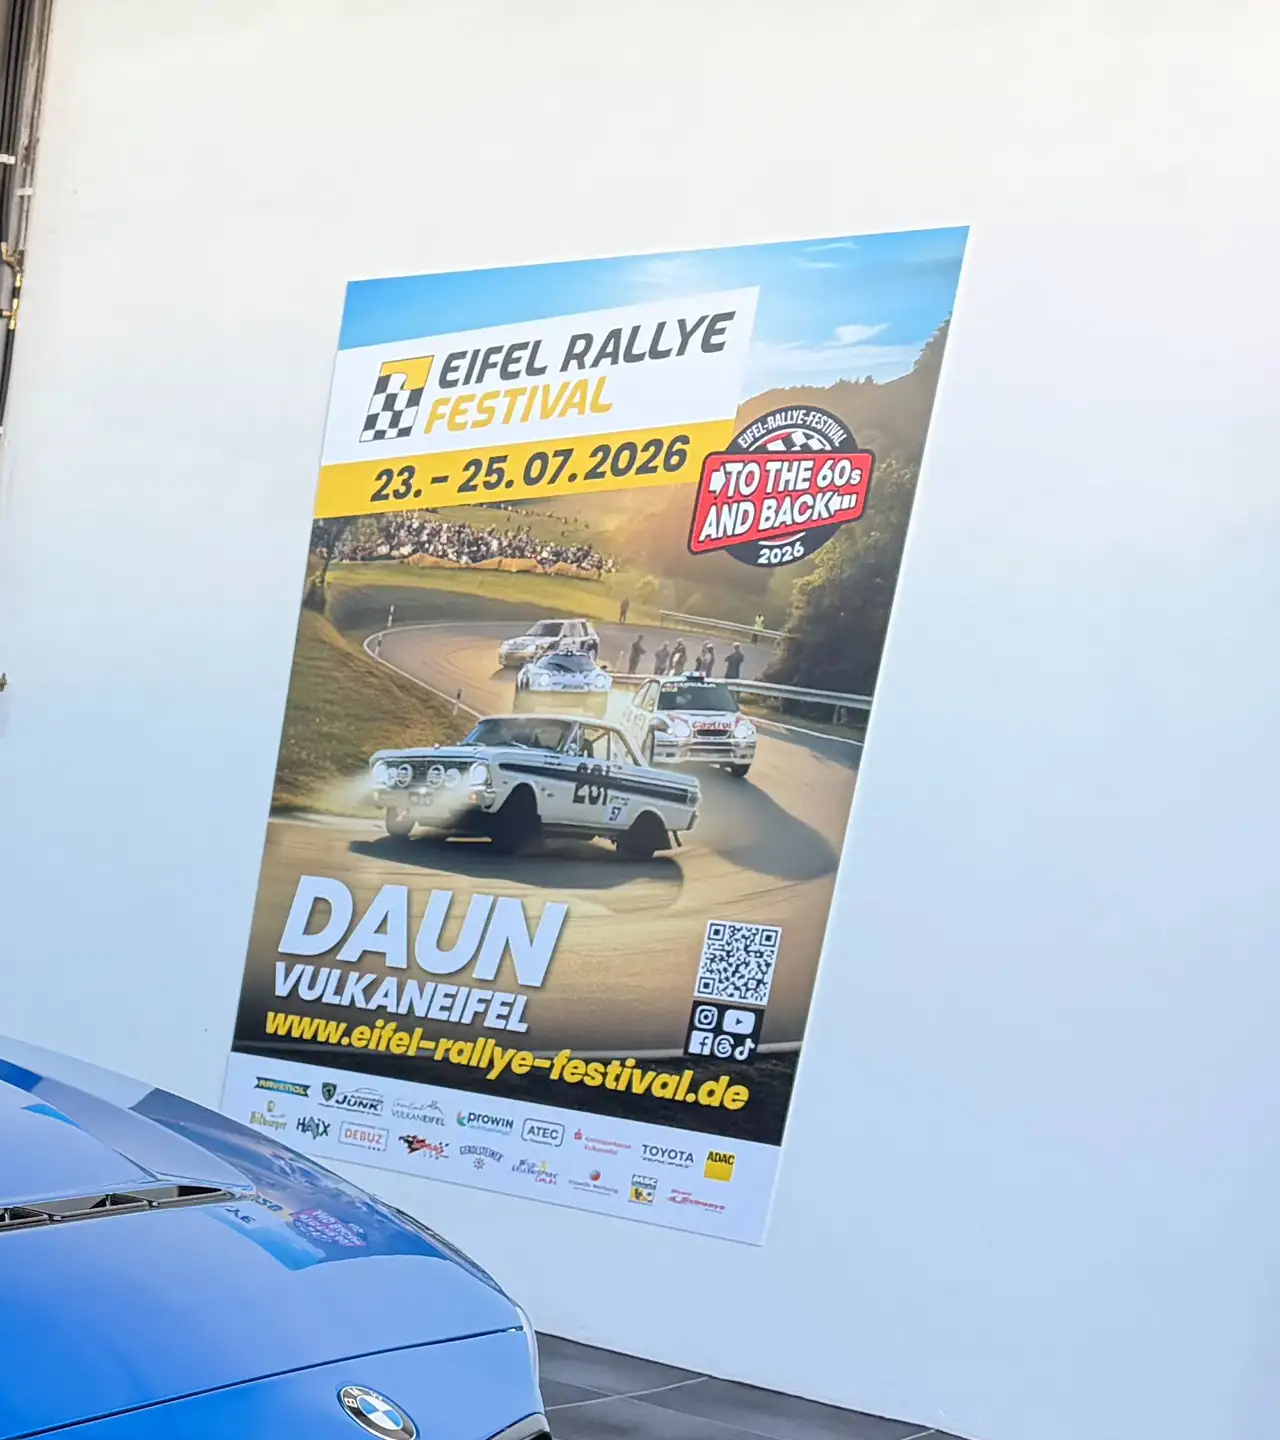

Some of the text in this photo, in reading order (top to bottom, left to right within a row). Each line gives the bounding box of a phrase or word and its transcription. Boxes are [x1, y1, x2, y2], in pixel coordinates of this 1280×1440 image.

[439, 311, 737, 389] EIFEL RALLYE
[423, 376, 614, 435] FESTIVAL
[737, 409, 848, 448] EIFEL-RALLYE-FESTIVAL
[370, 465, 423, 502] 23.
[725, 458, 862, 497] TO THE 60s
[699, 491, 834, 542] AND BACK
[757, 541, 805, 564] 2026
[278, 875, 569, 987] DAUN
[275, 961, 529, 1033] VULKANEIFEL
[265, 1011, 750, 1111] www.eifel-rallye-festival.de
[335, 1094, 380, 1112] JUNK
[391, 1109, 446, 1126] VULKANEIFEL
[344, 1128, 384, 1145] DEBUZ
[526, 1125, 559, 1140] ATEC
[641, 1144, 695, 1163] TOYOTA
[706, 1151, 736, 1166] ADAC
